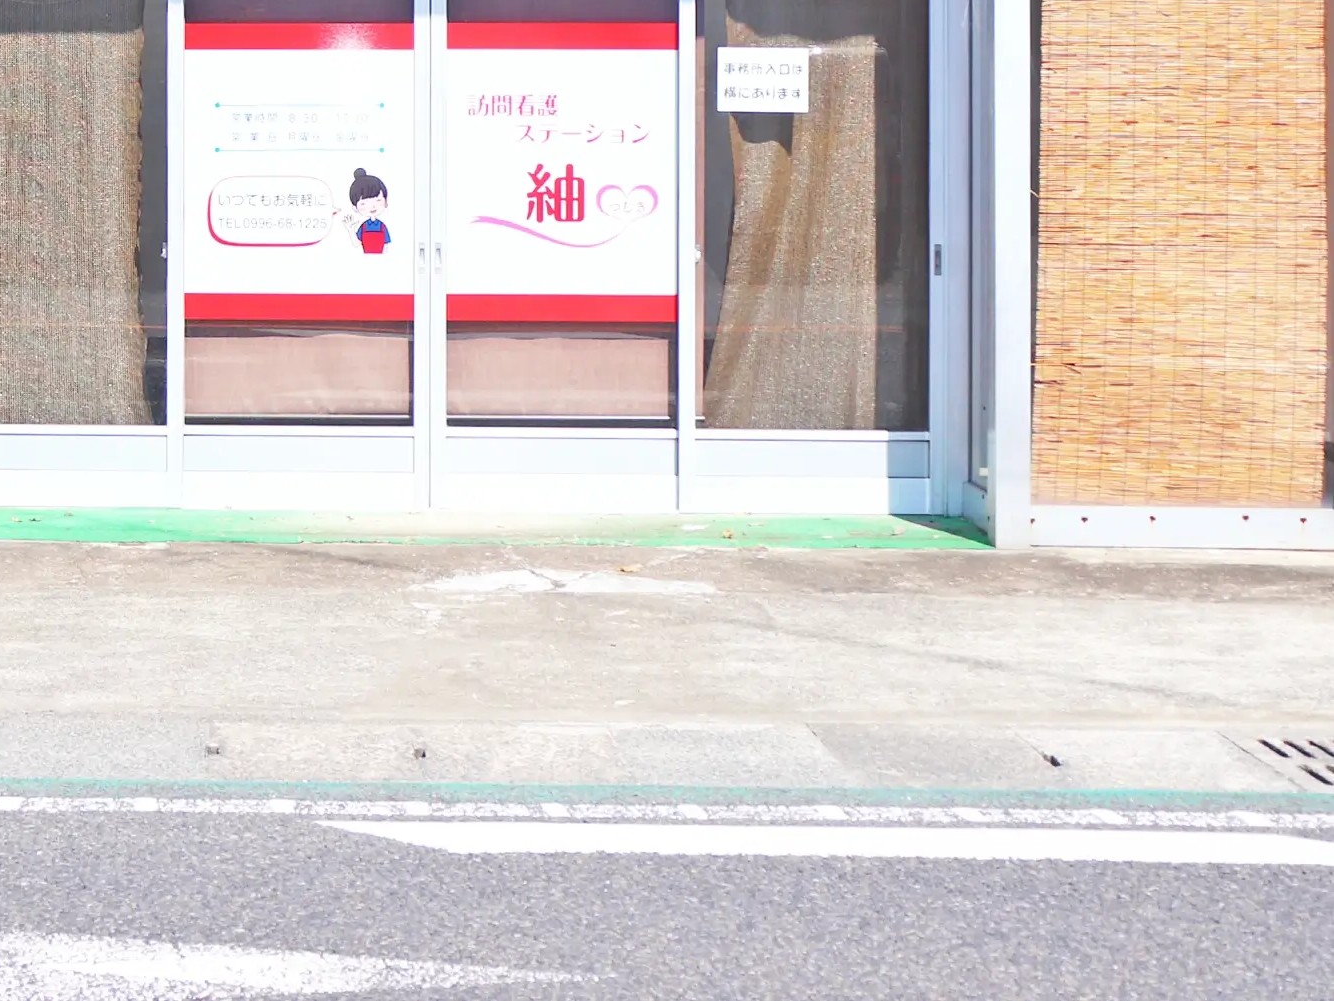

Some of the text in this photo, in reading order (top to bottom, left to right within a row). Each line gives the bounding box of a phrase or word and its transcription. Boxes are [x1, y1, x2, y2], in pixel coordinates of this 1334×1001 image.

[723, 62, 803, 75] 事務所入口は
[723, 85, 802, 99] 横にあります
[466, 94, 559, 117] 訪問看護
[515, 123, 651, 144] ステーション
[526, 162, 586, 223] 紬
